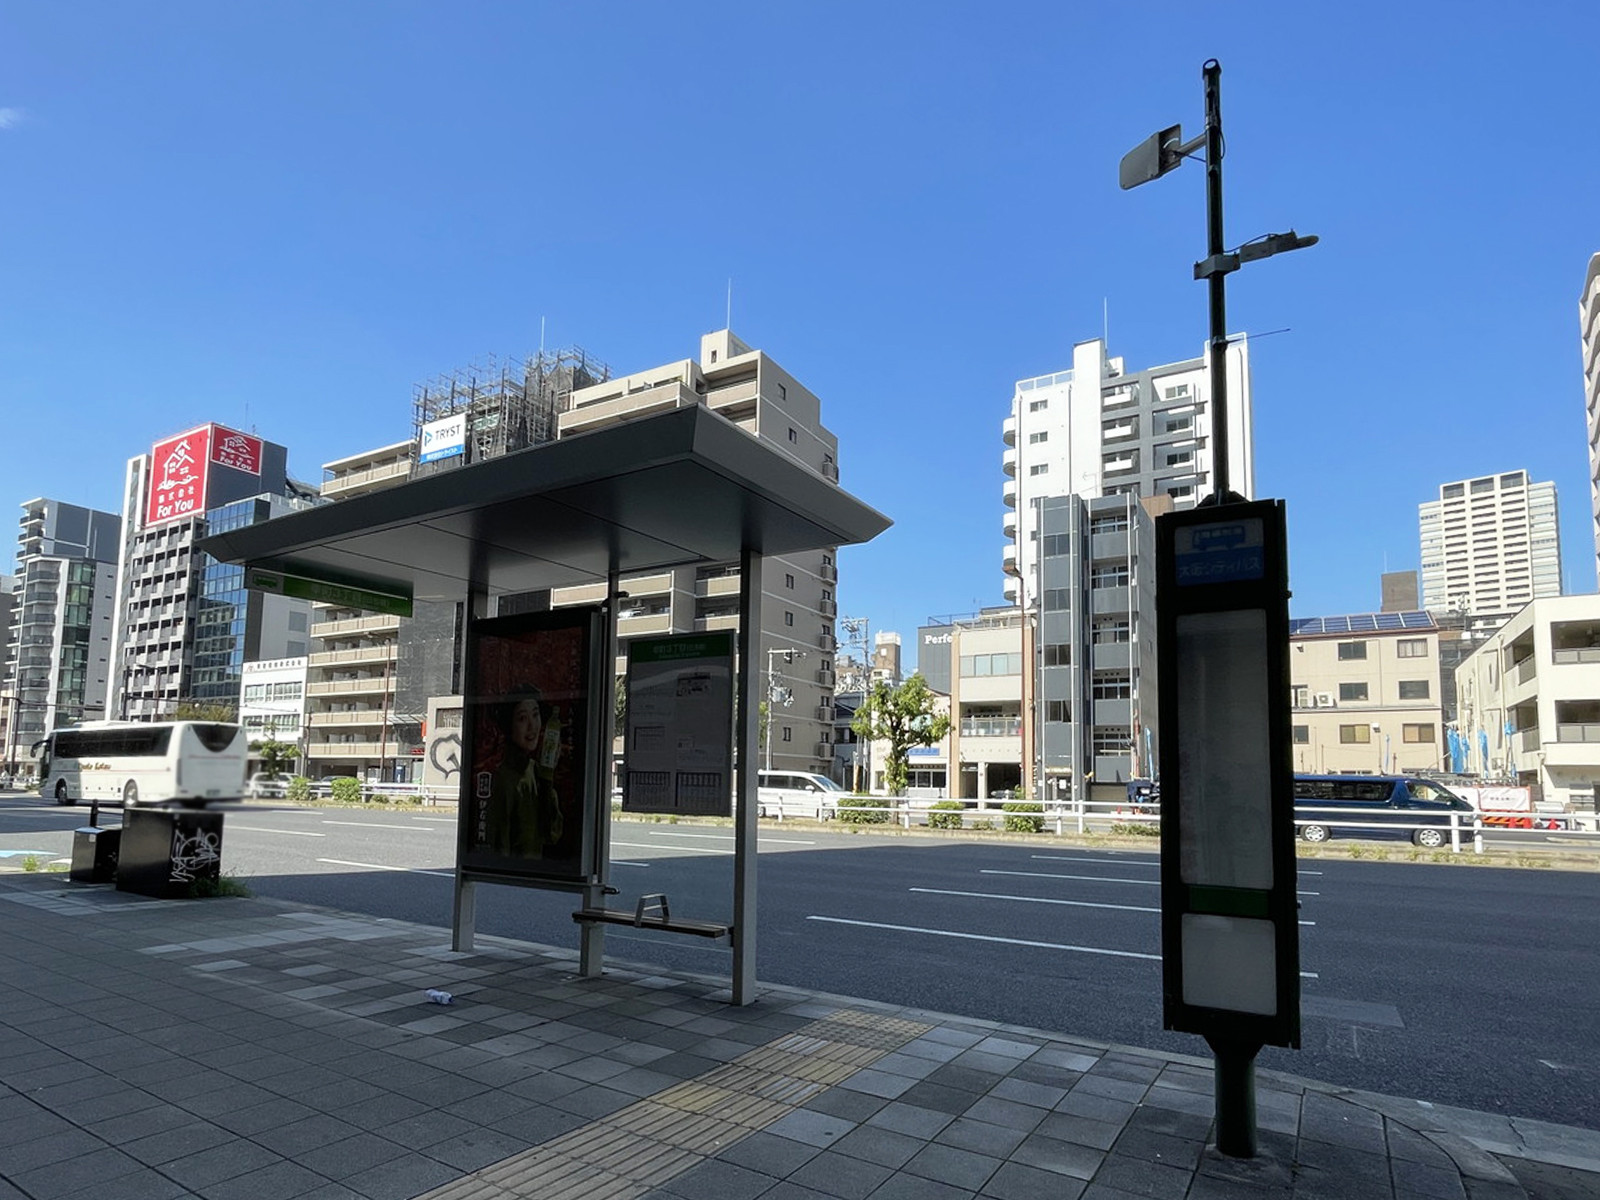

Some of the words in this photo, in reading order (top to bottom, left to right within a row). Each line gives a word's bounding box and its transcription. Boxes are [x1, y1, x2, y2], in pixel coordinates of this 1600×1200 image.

[435, 424, 461, 440] TRYST
[219, 456, 234, 466] For
[235, 460, 253, 471] You
[157, 504, 173, 518] For
